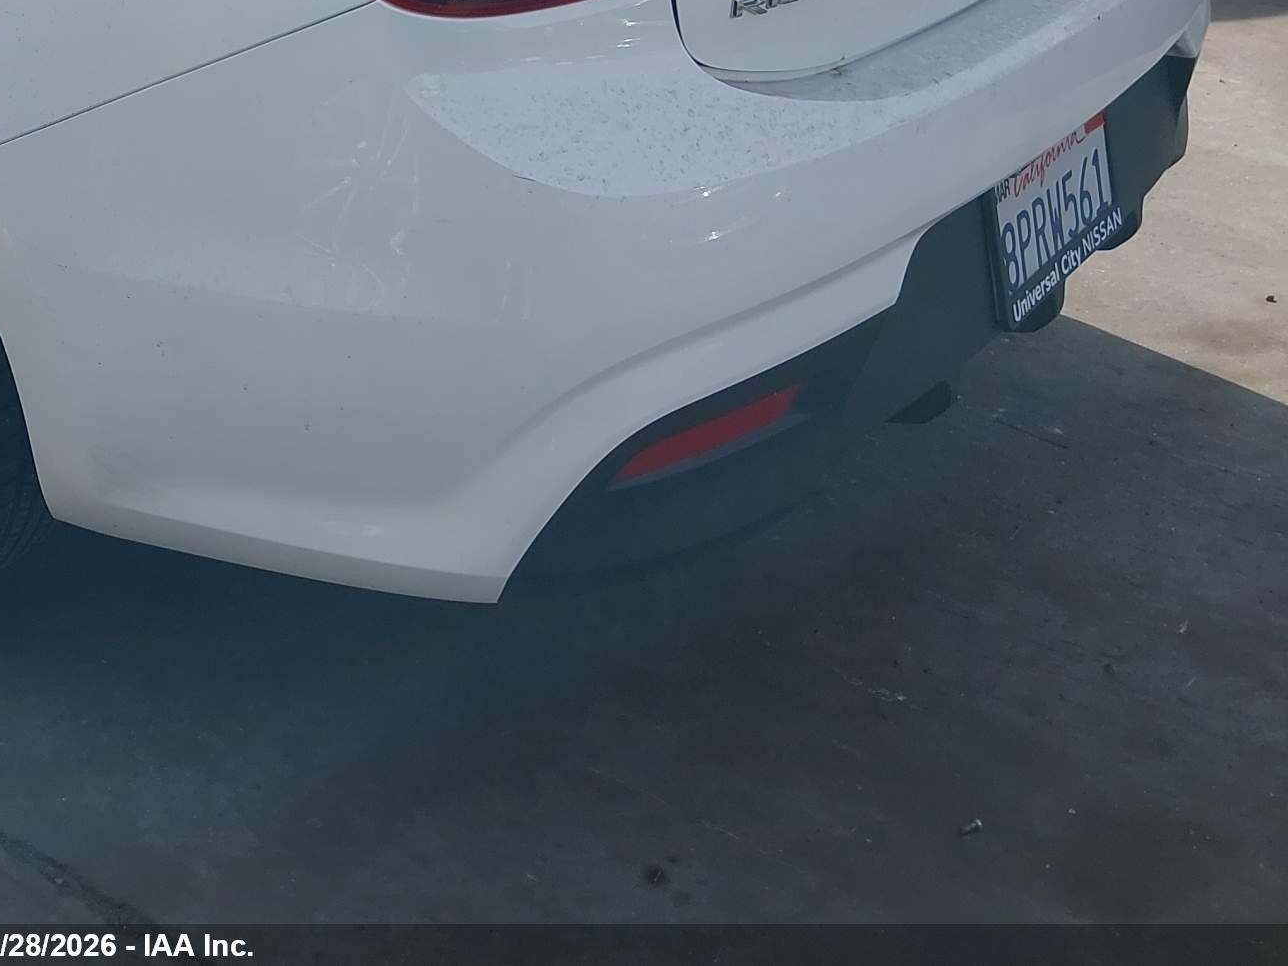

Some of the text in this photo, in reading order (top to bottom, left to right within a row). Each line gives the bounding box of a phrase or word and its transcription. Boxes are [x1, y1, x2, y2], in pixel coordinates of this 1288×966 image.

[1001, 148, 1109, 289] 8PRW561
[1013, 130, 1086, 197] California
[1012, 208, 1123, 322] Universal City NISSAN
